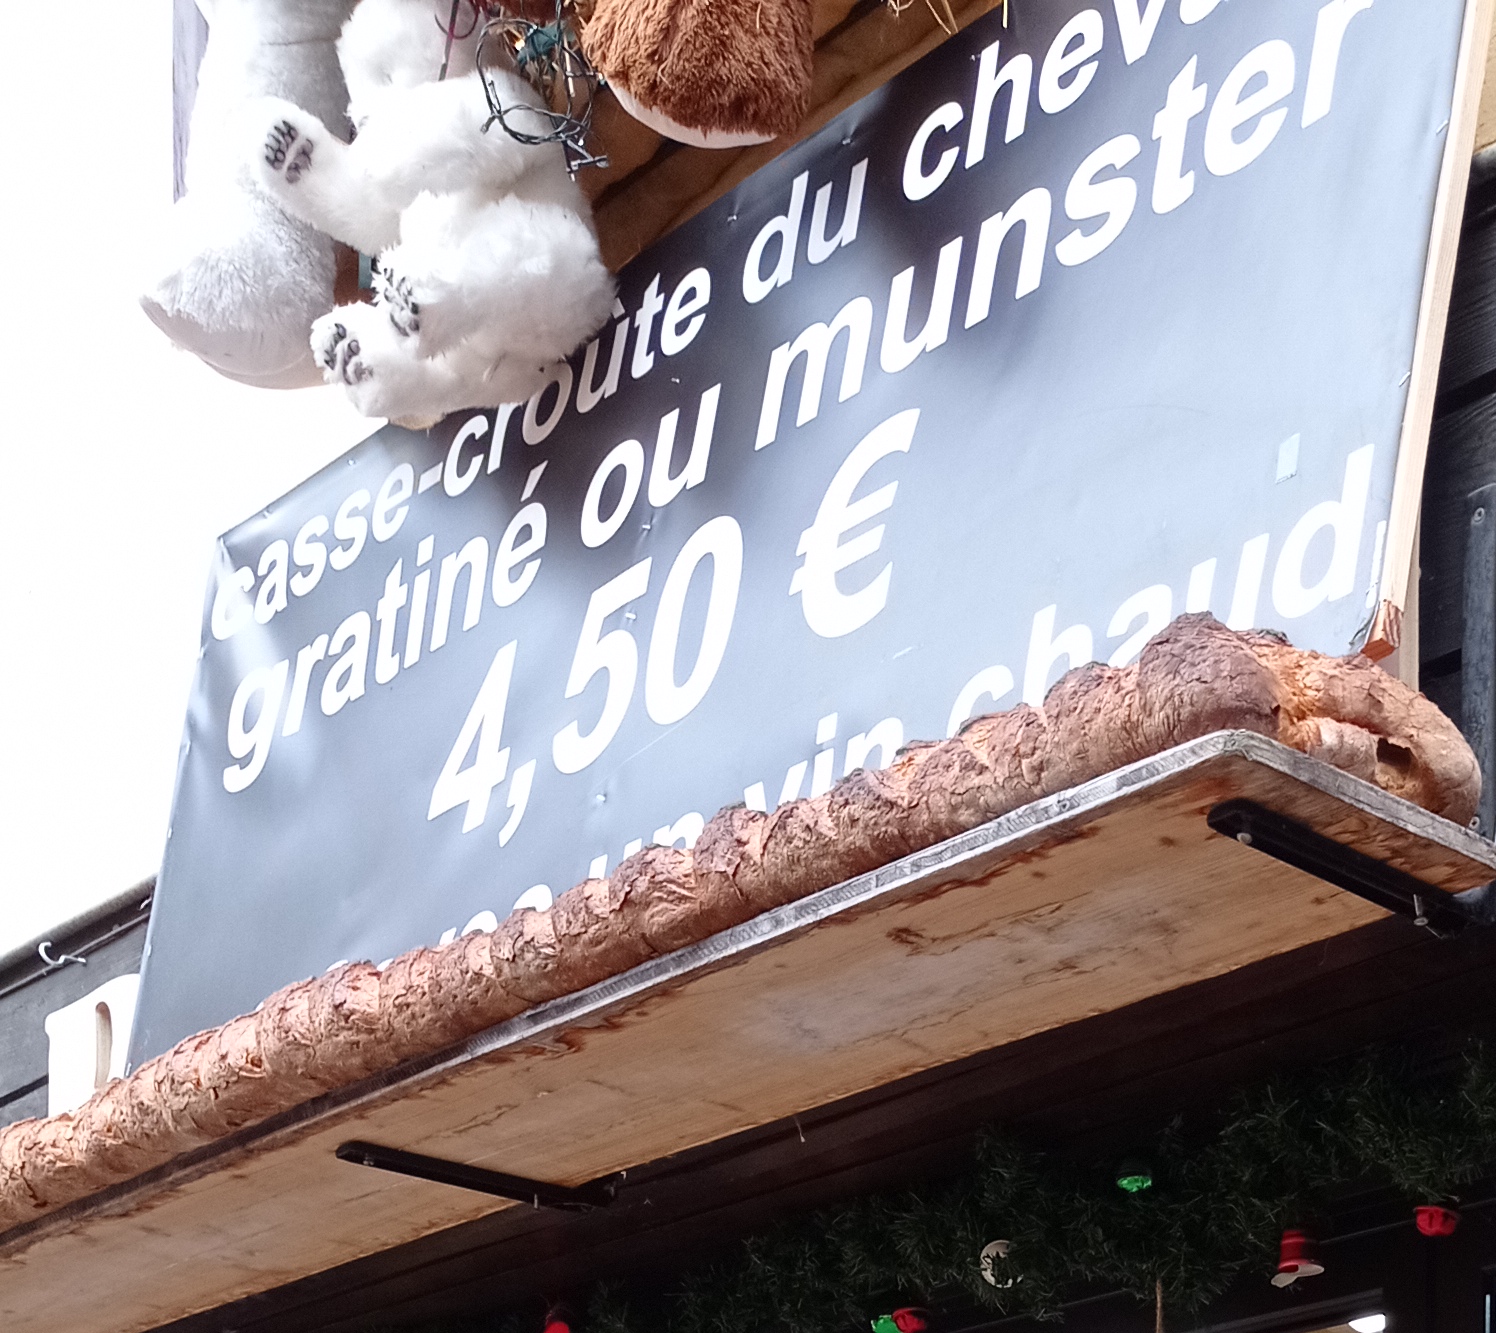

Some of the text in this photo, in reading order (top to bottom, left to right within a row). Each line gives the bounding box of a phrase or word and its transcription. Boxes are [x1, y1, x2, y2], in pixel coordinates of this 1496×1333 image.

[222, 0, 1374, 795] gratiné ou munster
[742, 157, 868, 304] du
[427, 407, 922, 848] 4,50 €
